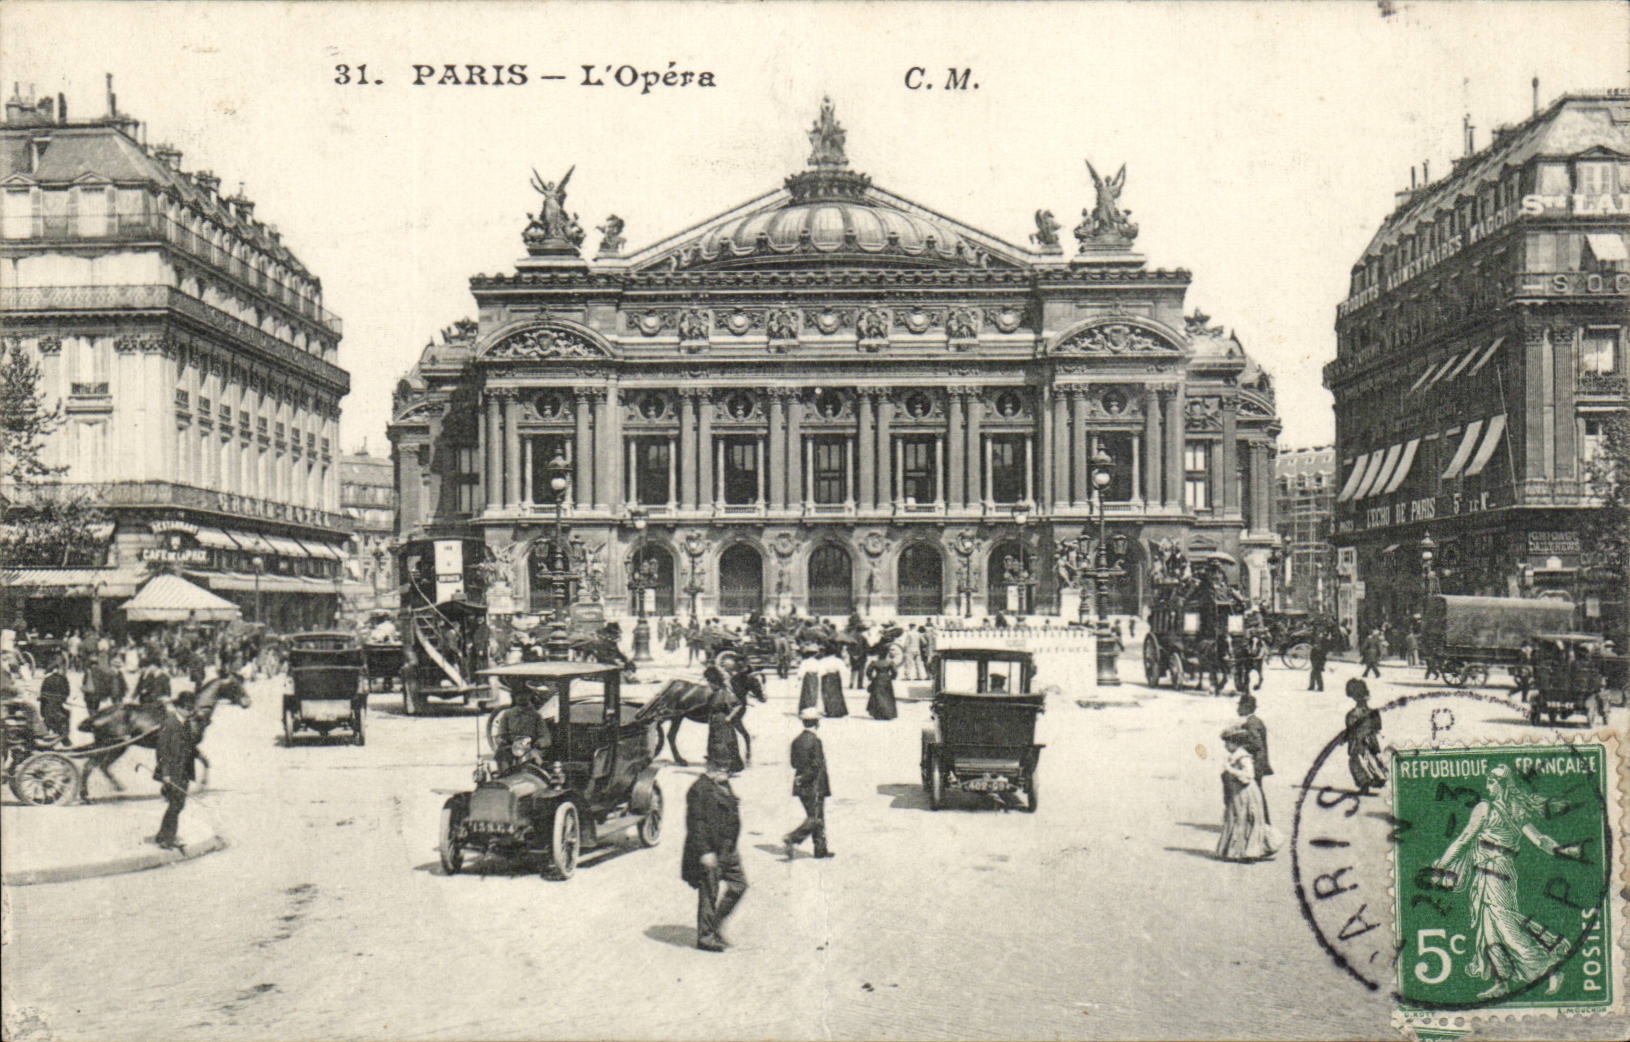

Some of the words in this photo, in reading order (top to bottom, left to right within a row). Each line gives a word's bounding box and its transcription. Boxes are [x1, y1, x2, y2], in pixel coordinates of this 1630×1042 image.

[1395, 502, 1407, 524] DE
[1411, 497, 1436, 521] PARIS
[1401, 760, 1488, 778] REPUBLIQUE
[1581, 907, 1602, 992] POSTES
